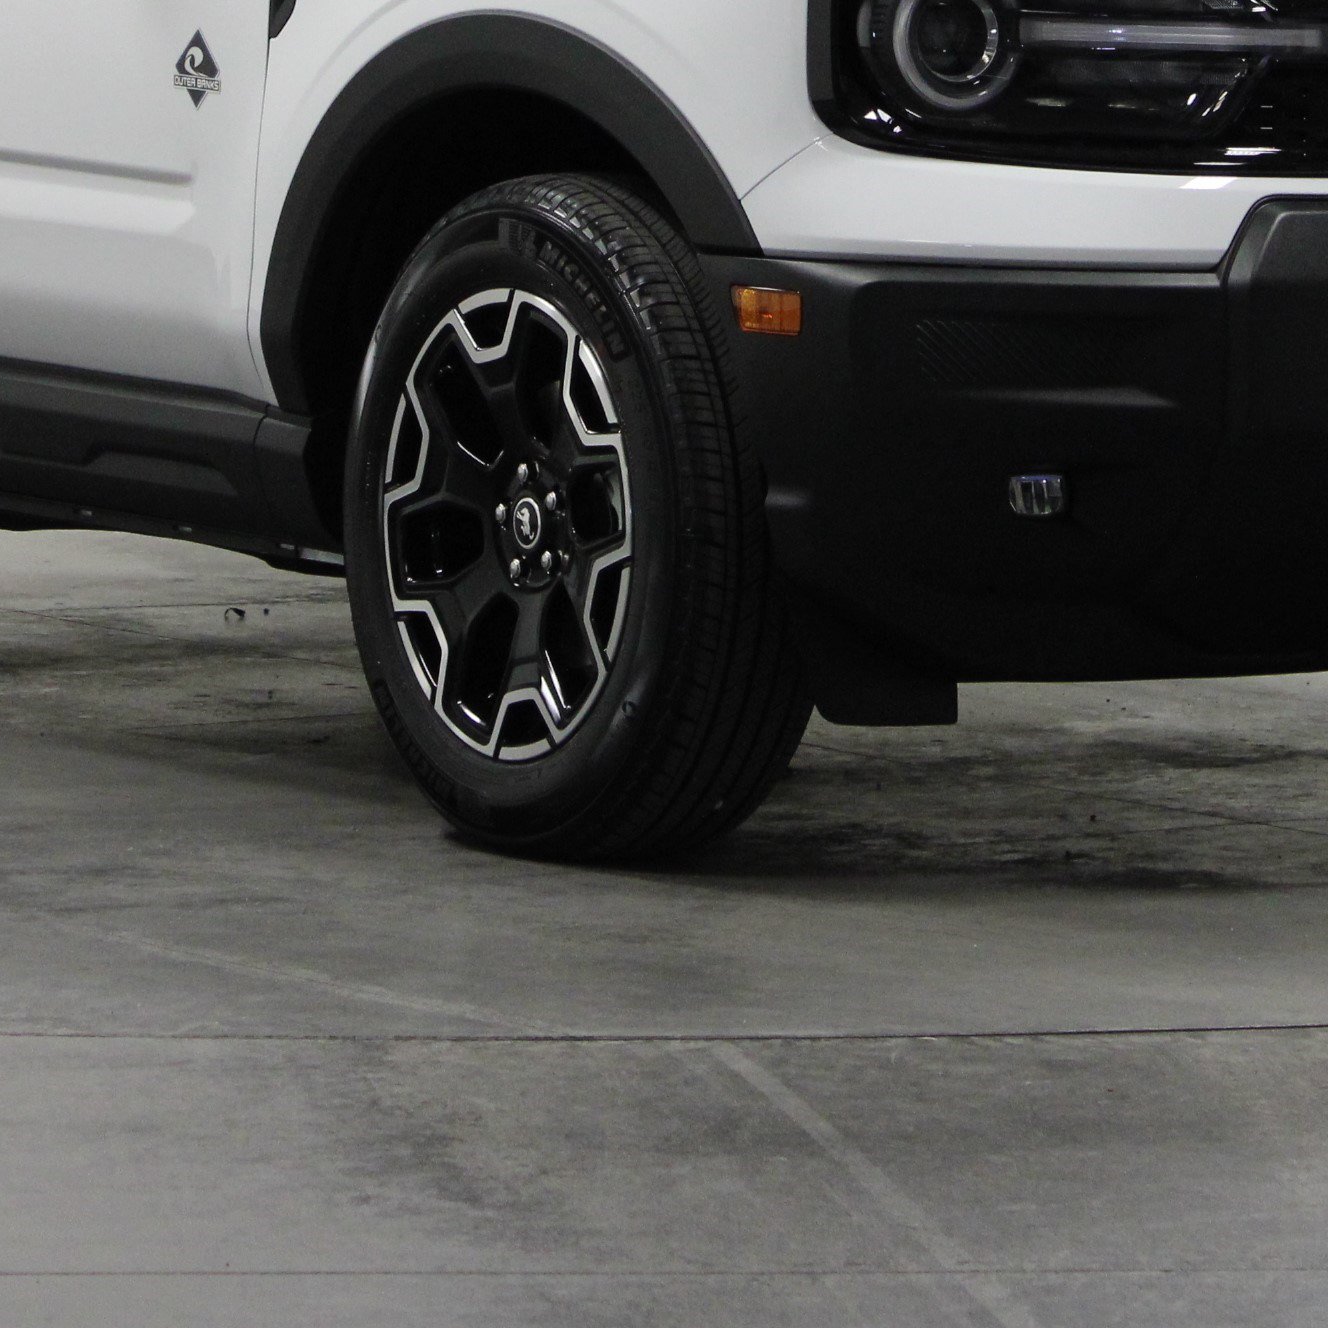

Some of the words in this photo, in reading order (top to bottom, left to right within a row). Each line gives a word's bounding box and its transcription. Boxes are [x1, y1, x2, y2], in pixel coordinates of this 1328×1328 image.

[174, 75, 196, 87] OUTER
[197, 78, 219, 91] BANKS
[538, 239, 627, 357] MICHELIN
